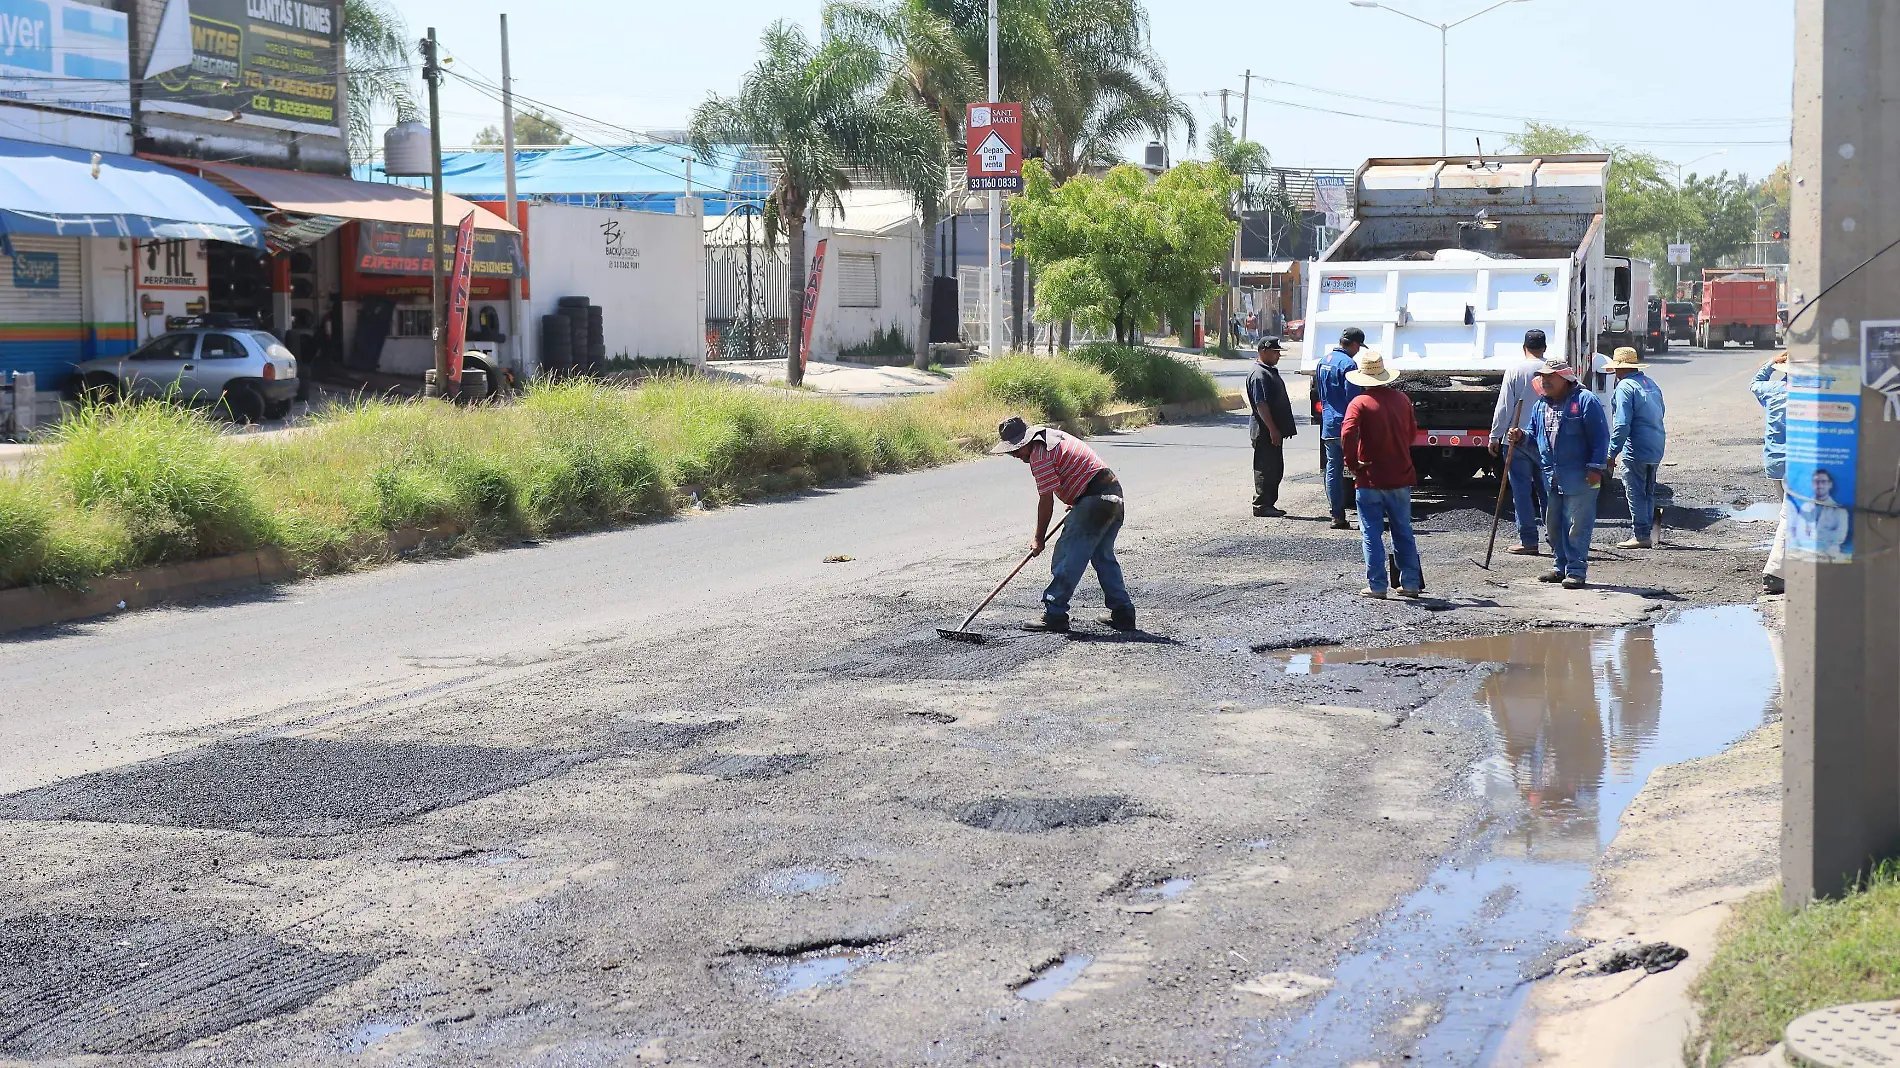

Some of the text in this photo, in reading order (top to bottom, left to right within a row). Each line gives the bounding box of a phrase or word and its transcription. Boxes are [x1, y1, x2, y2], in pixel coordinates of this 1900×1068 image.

[247, 0, 331, 34] LLANTAS Y RINES
[0, 13, 44, 56] yer
[252, 95, 272, 111] CEL
[983, 147, 1004, 155] Depas
[971, 177, 1017, 188] 33 1160 0838
[360, 255, 420, 270] EXPERTOS
[421, 258, 434, 270] EN
[144, 276, 197, 285] PERFORMANCE
